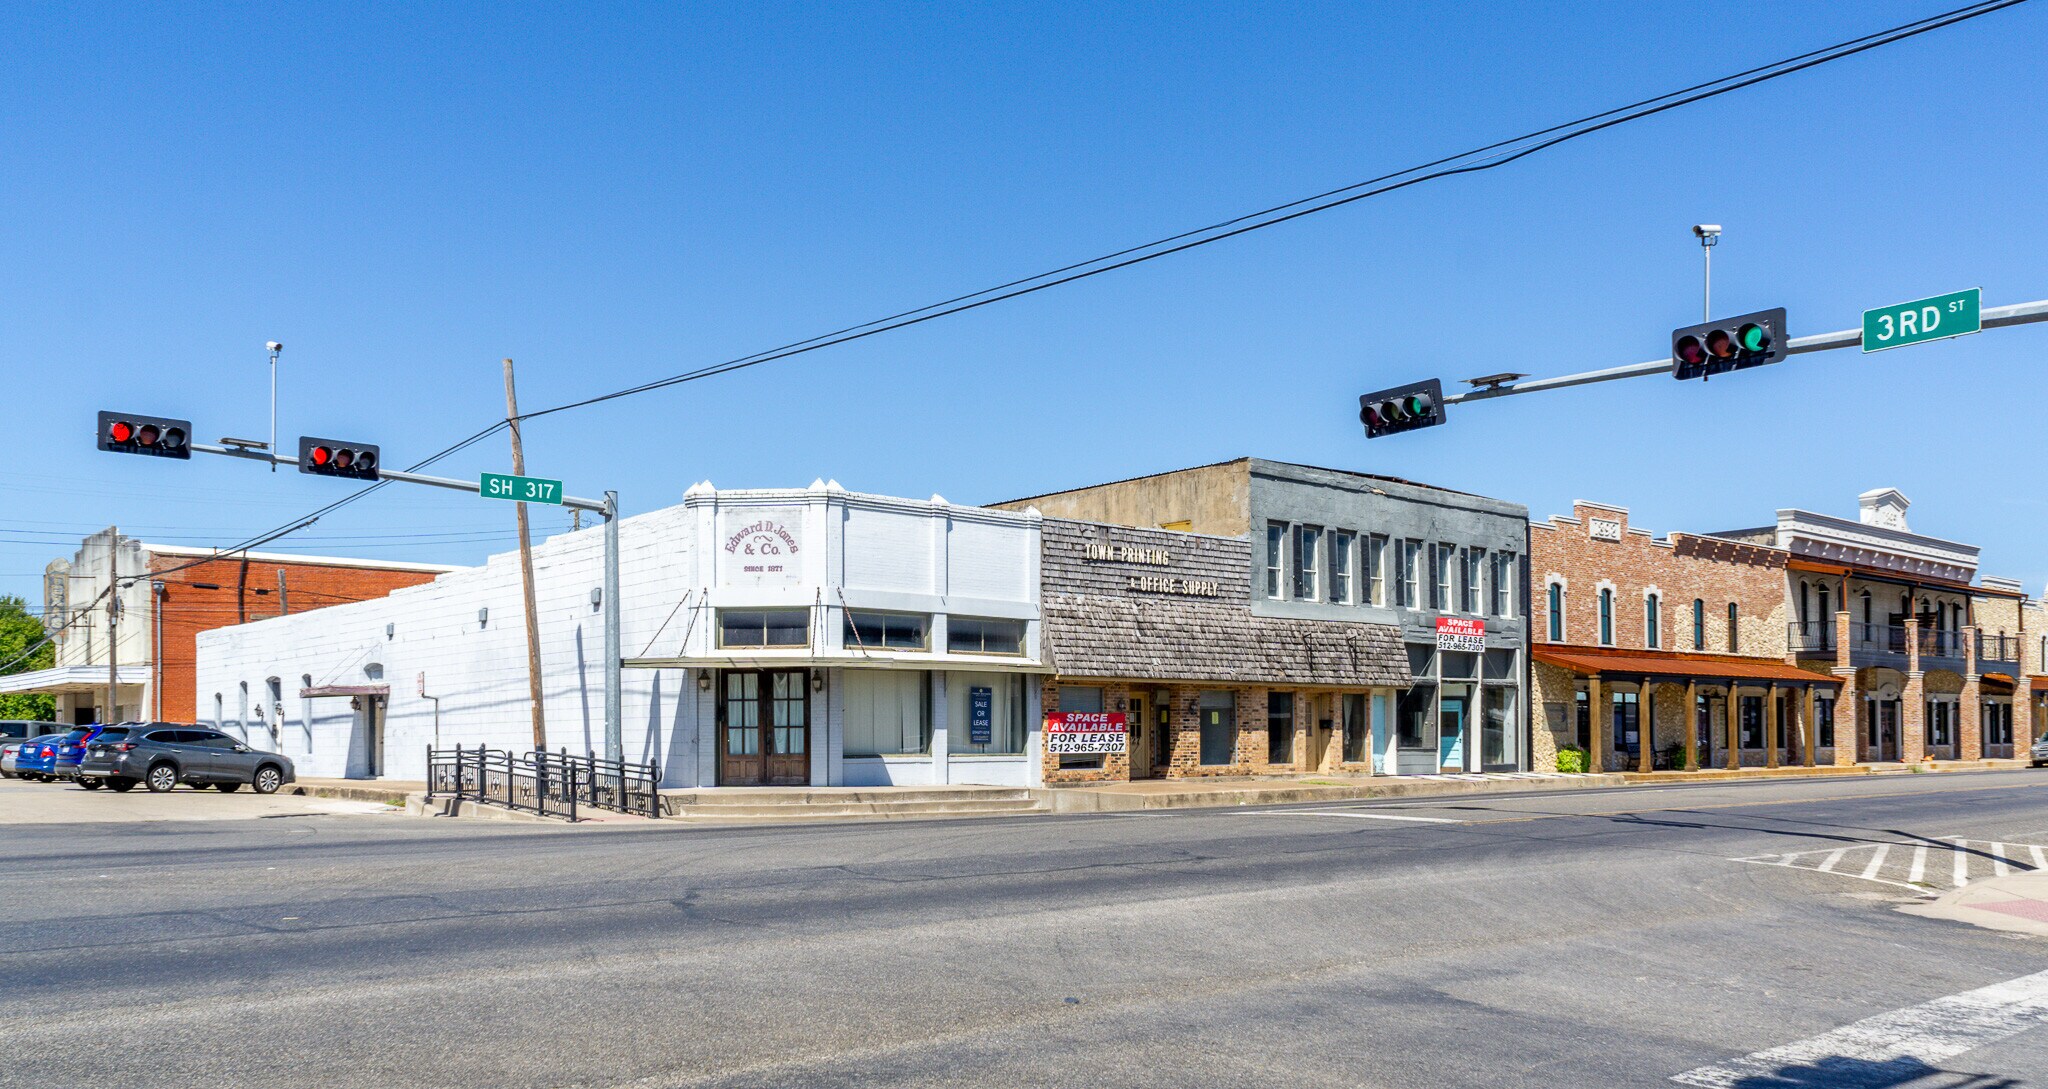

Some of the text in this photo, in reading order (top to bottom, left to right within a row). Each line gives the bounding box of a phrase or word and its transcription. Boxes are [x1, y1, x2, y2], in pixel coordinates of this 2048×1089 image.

[1876, 299, 1966, 341] 3RD ST
[489, 478, 555, 499] SH 317
[724, 520, 799, 555] Edward D. Jones
[744, 543, 781, 556] & Co.
[1085, 543, 1169, 566] TOWN PRINTING
[743, 565, 764, 573] SINCE
[1130, 576, 1219, 597] & OFFICE SUPPLY
[1447, 618, 1474, 628] SPACE
[1437, 625, 1484, 636] AVAILABLE
[1438, 634, 1484, 645] FOR LEASE
[1438, 641, 1484, 652] 512-965-7307
[974, 700, 988, 708] SALE
[973, 719, 989, 727] LEASE
[1066, 713, 1109, 722] SPACE
[1050, 722, 1124, 732] AVAILABLE
[1050, 733, 1077, 743] FOR
[1081, 733, 1124, 743] LEASE
[1049, 743, 1125, 752] 512-965-7307
